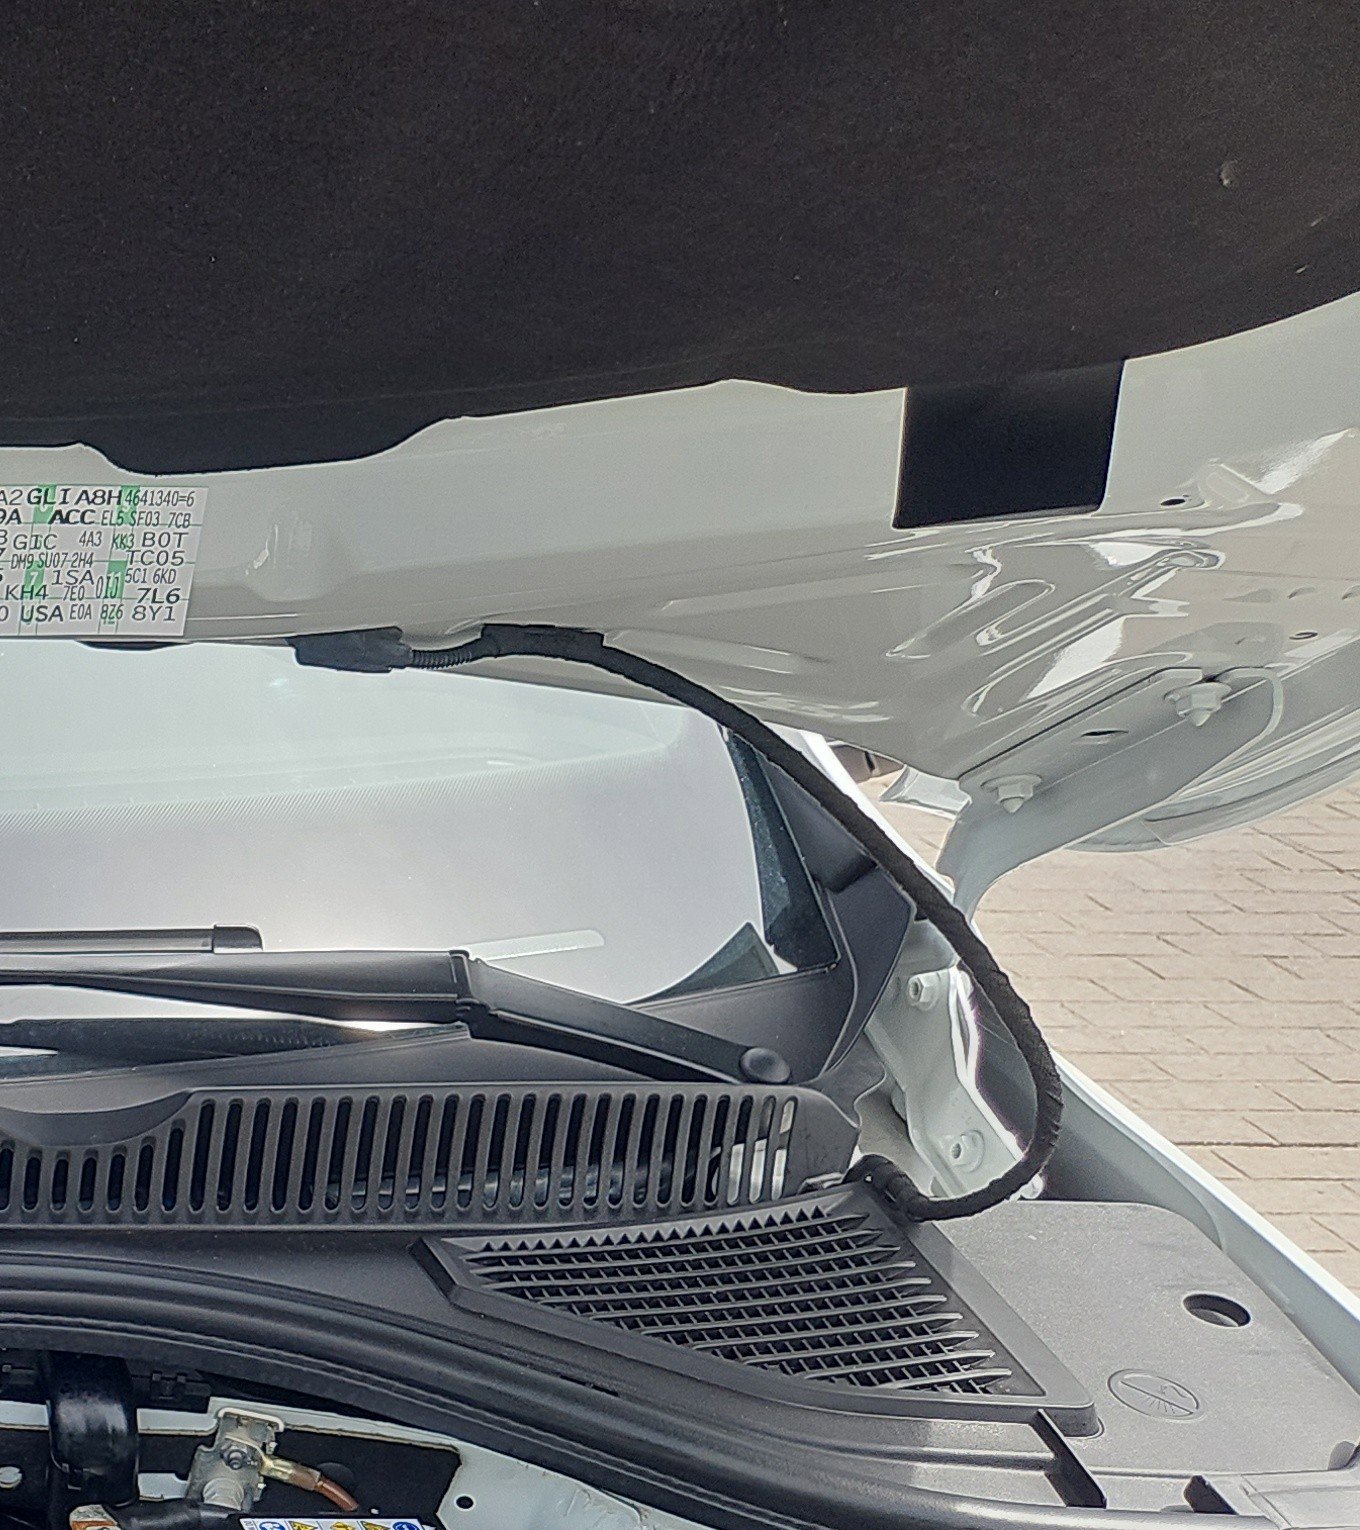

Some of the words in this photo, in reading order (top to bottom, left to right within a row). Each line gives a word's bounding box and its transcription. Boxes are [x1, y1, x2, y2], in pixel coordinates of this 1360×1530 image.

[48, 508, 96, 525] ACC
[79, 530, 103, 547] 4A3
[51, 569, 95, 586] 1SA
[5, 584, 49, 601] KH4
[136, 587, 181, 605] 7L6
[20, 604, 64, 622] USA
[131, 604, 176, 622] 8Y1
